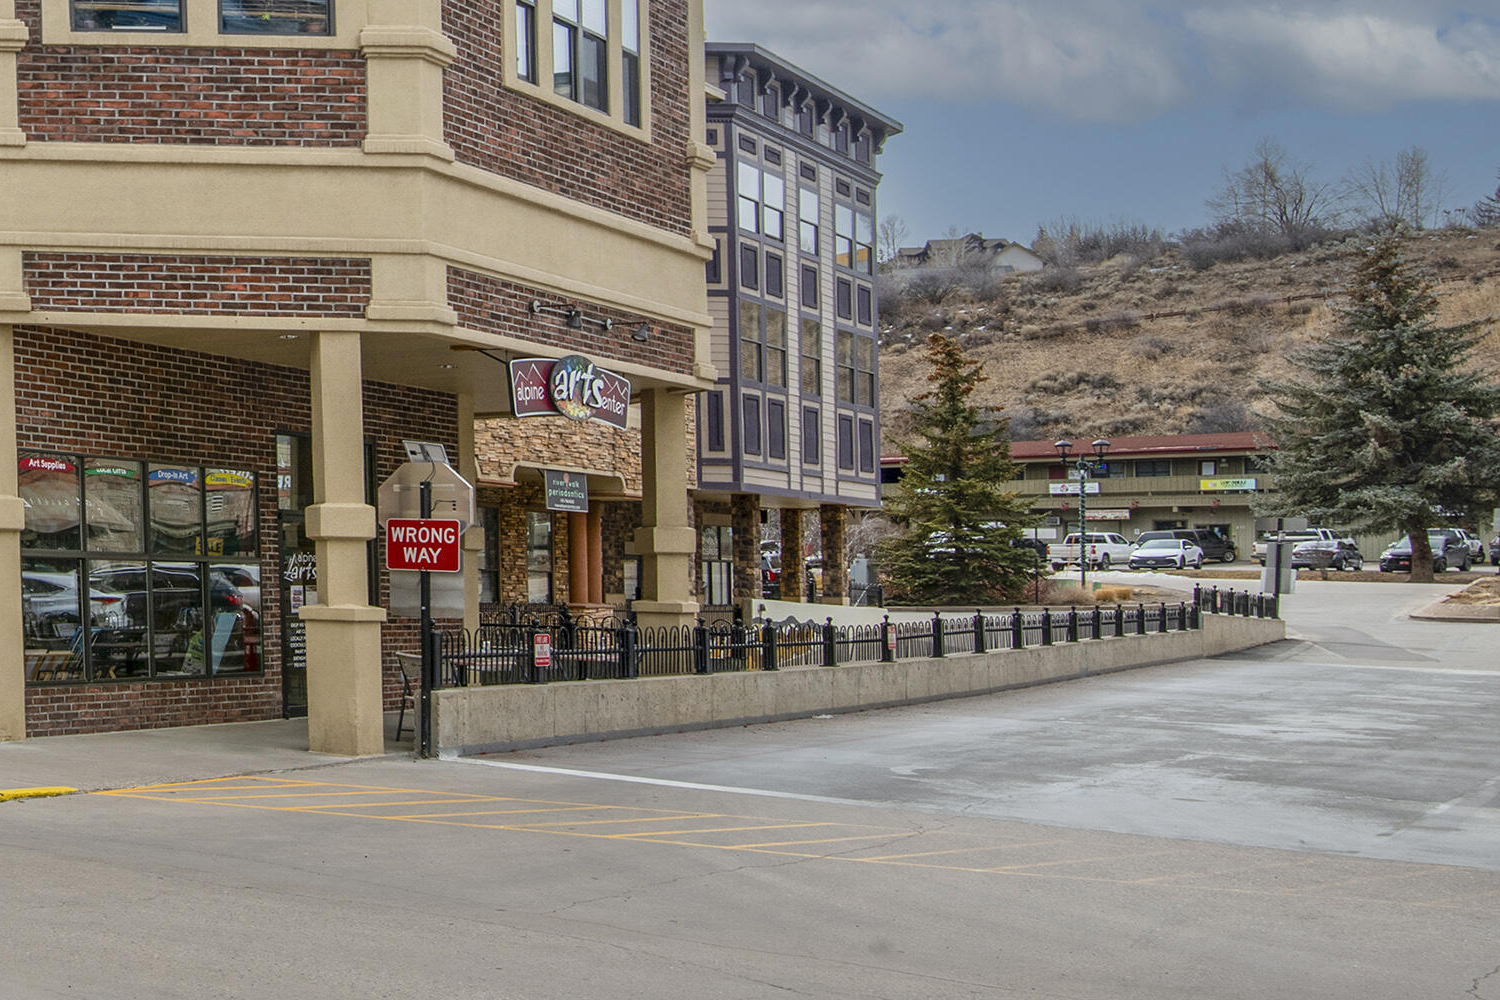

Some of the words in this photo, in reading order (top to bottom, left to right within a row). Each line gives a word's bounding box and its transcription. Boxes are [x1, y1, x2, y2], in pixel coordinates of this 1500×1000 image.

[517, 381, 545, 405] alpine
[553, 363, 604, 408] arts
[28, 459, 40, 467] Art
[41, 459, 66, 470] Supplies
[178, 471, 189, 480] Art
[548, 488, 585, 499] periodontics
[391, 526, 456, 544] WRONG
[403, 546, 442, 564] WAY
